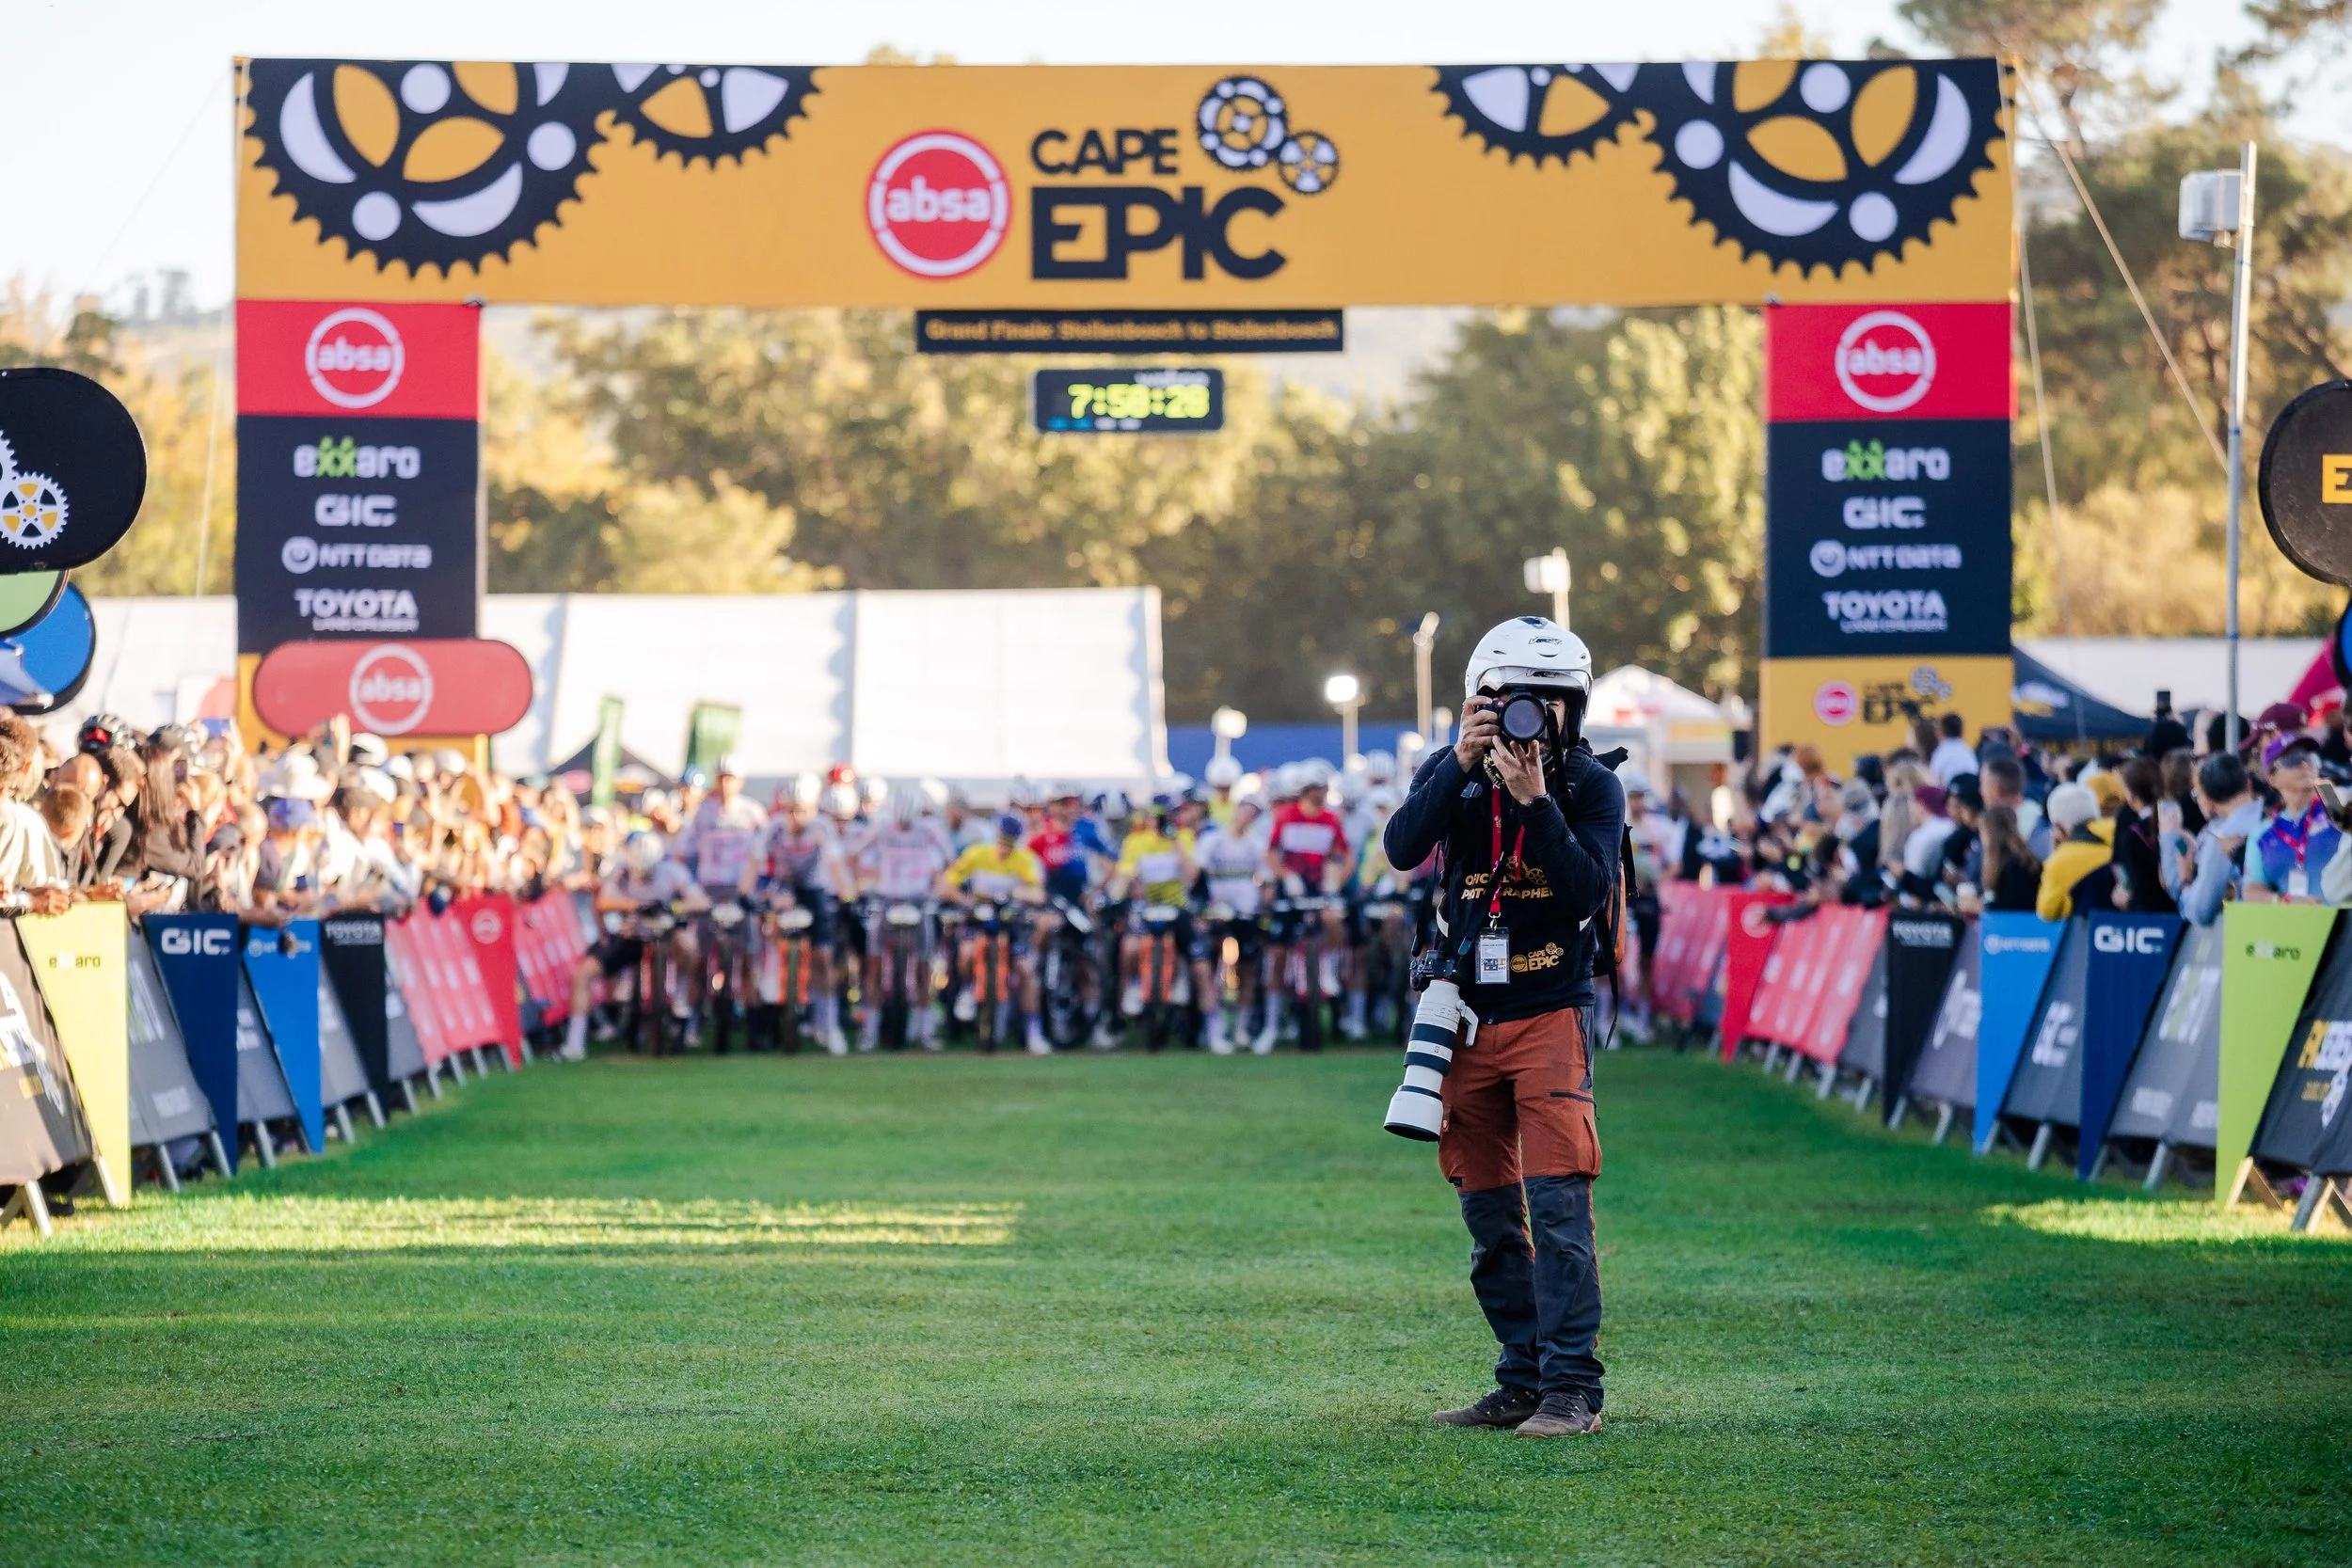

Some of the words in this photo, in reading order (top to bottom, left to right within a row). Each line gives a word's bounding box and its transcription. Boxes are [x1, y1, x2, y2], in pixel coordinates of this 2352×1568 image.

[1030, 128, 1179, 176] CAPE
[885, 175, 993, 222] absa
[1030, 185, 1287, 281] EPIC
[317, 336, 391, 372] absa
[1847, 339, 1923, 376] absa
[294, 436, 421, 479] exxaro
[1821, 440, 1950, 482] exxaro
[315, 495, 397, 527] GIC
[1843, 497, 1926, 529] GIC
[294, 588, 419, 618] TOYOTA
[1822, 590, 1947, 620] TOYOTA
[359, 670, 422, 703] absa
[162, 927, 231, 955] GIC
[2094, 926, 2164, 953] GIC
[1528, 955, 1559, 971] EPIC
